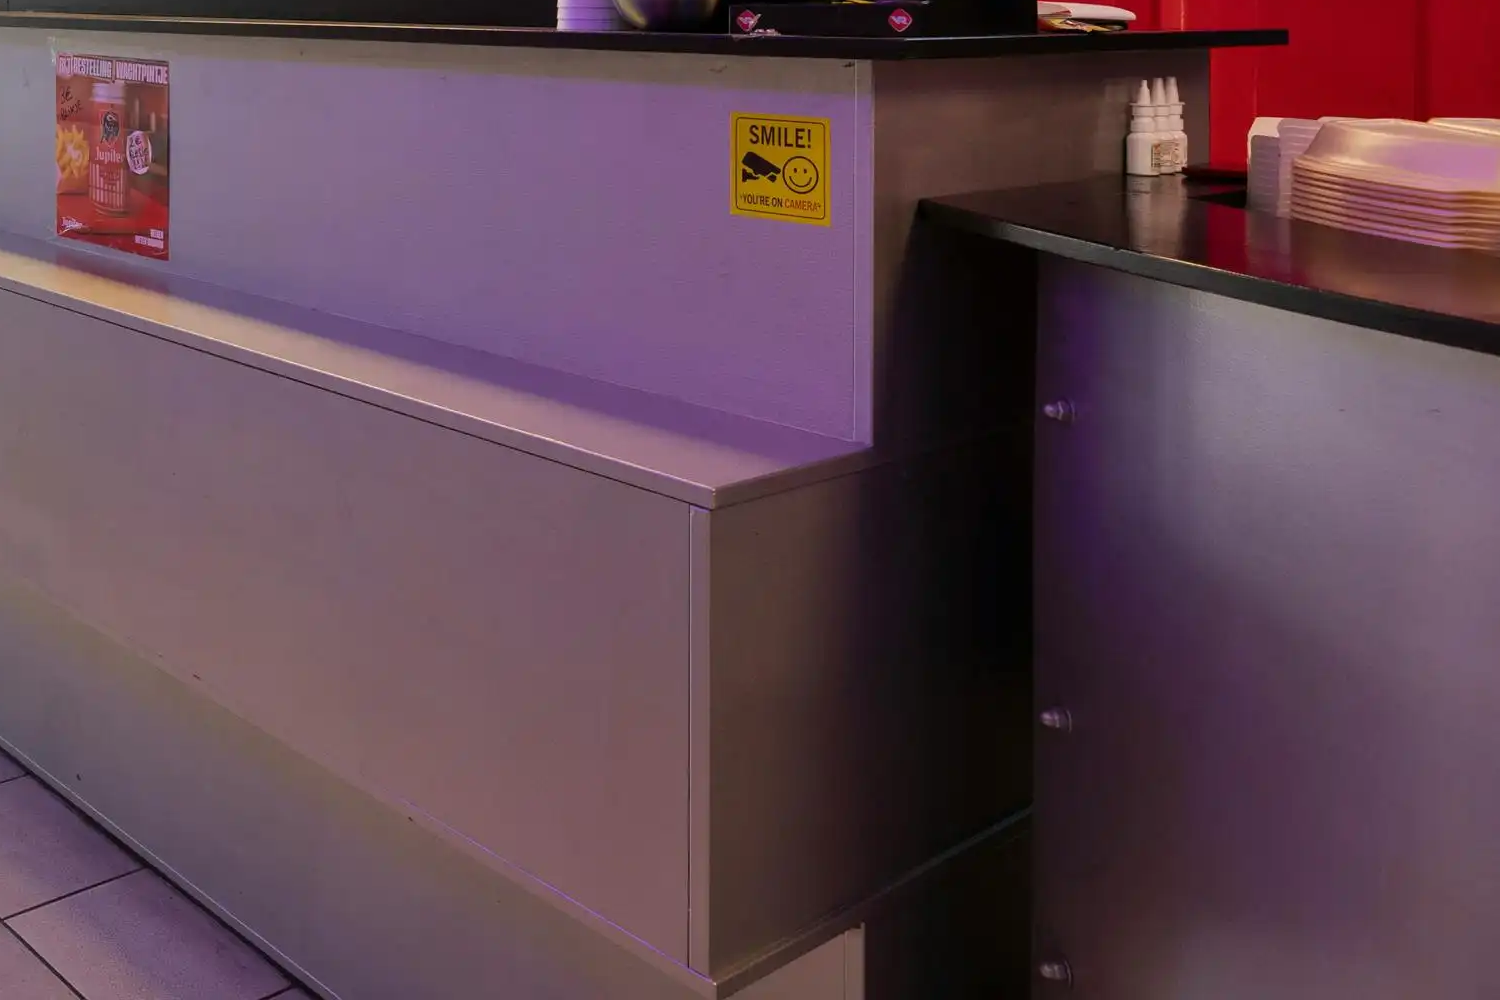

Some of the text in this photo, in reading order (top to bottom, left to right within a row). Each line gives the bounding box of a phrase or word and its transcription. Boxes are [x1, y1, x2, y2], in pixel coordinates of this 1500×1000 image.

[73, 57, 112, 79] BESTELLING
[115, 60, 168, 85] WACHTPINTJE
[748, 124, 812, 149] SMILE!
[743, 193, 818, 212] YOU'RE ON CAMERA
